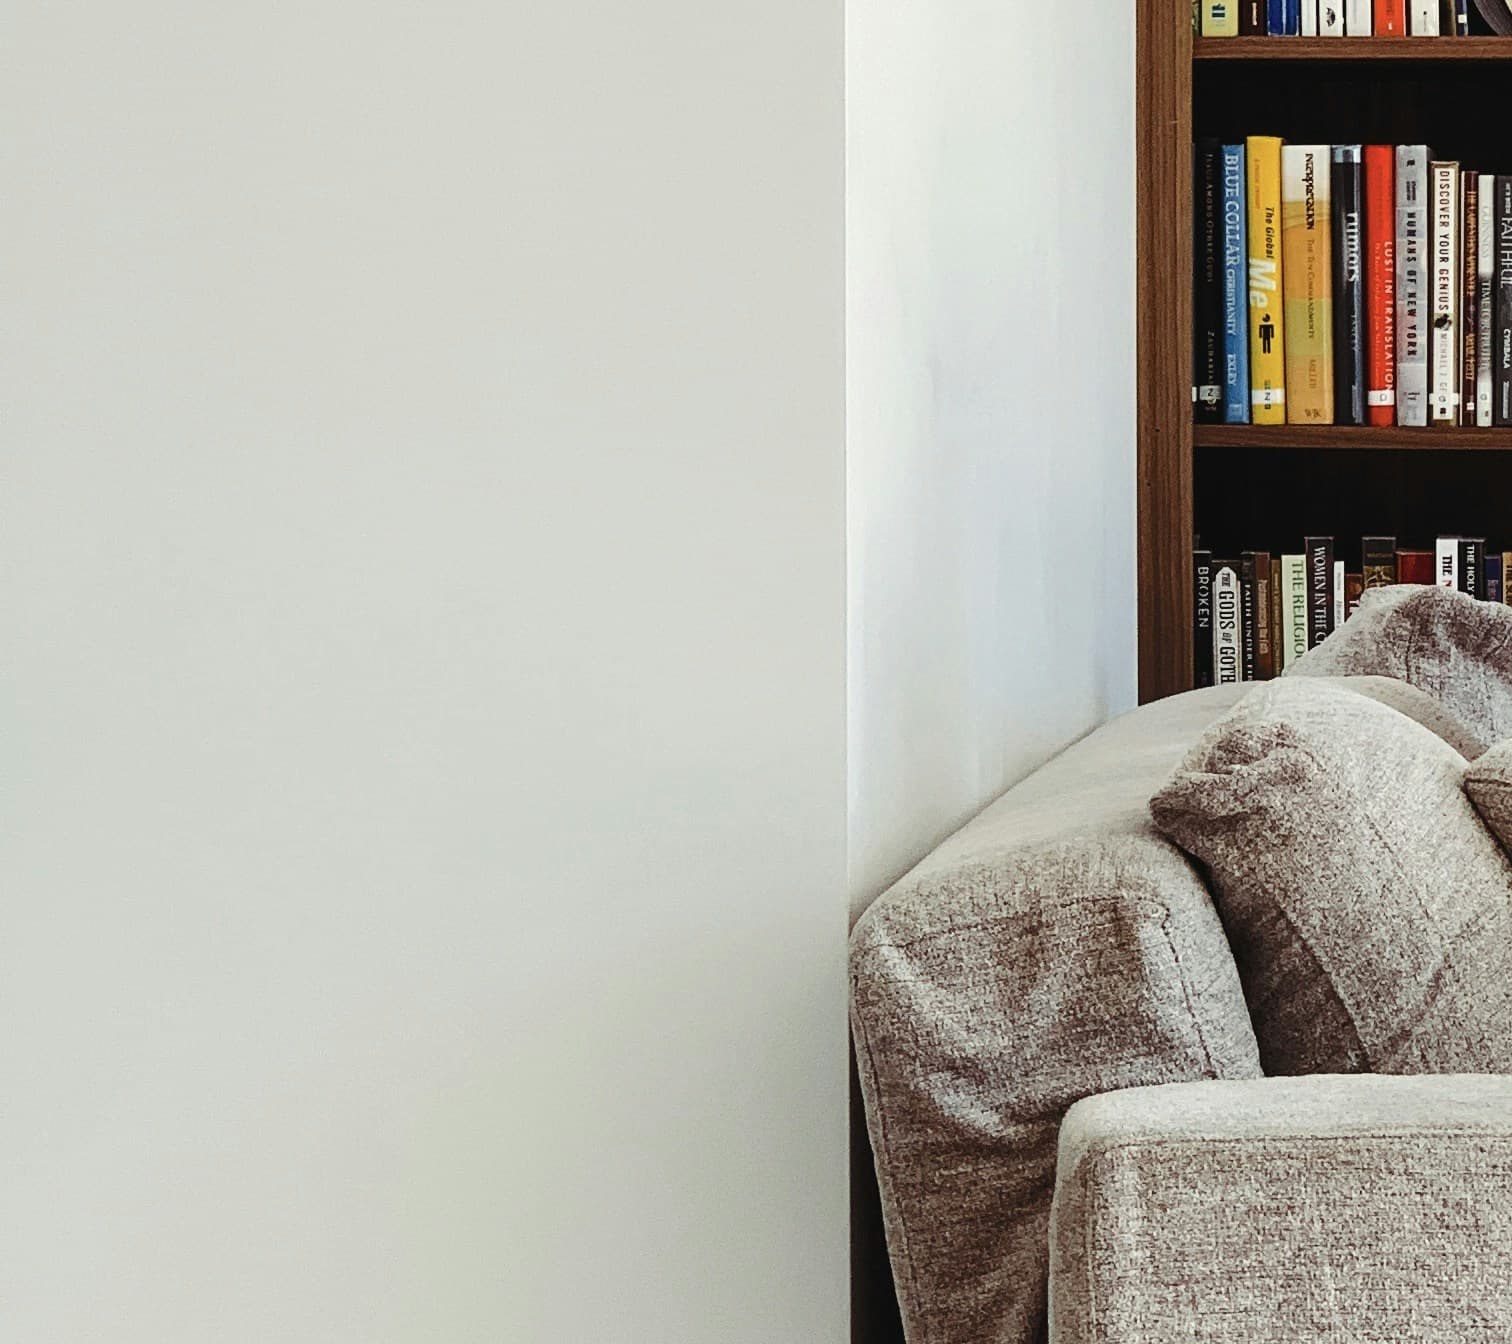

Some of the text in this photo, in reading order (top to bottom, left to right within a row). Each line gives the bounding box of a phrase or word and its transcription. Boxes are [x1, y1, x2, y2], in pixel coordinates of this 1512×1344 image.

[1225, 154, 1239, 386] BLUE COLLAR CHRISTIANITY EXLEY
[1249, 207, 1276, 308] The Global Me
[1438, 170, 1450, 311] DISCOVER YOUR GENIUS
[1197, 566, 1209, 628] BROKEN
[1314, 547, 1326, 630] WOMEN IN THE
